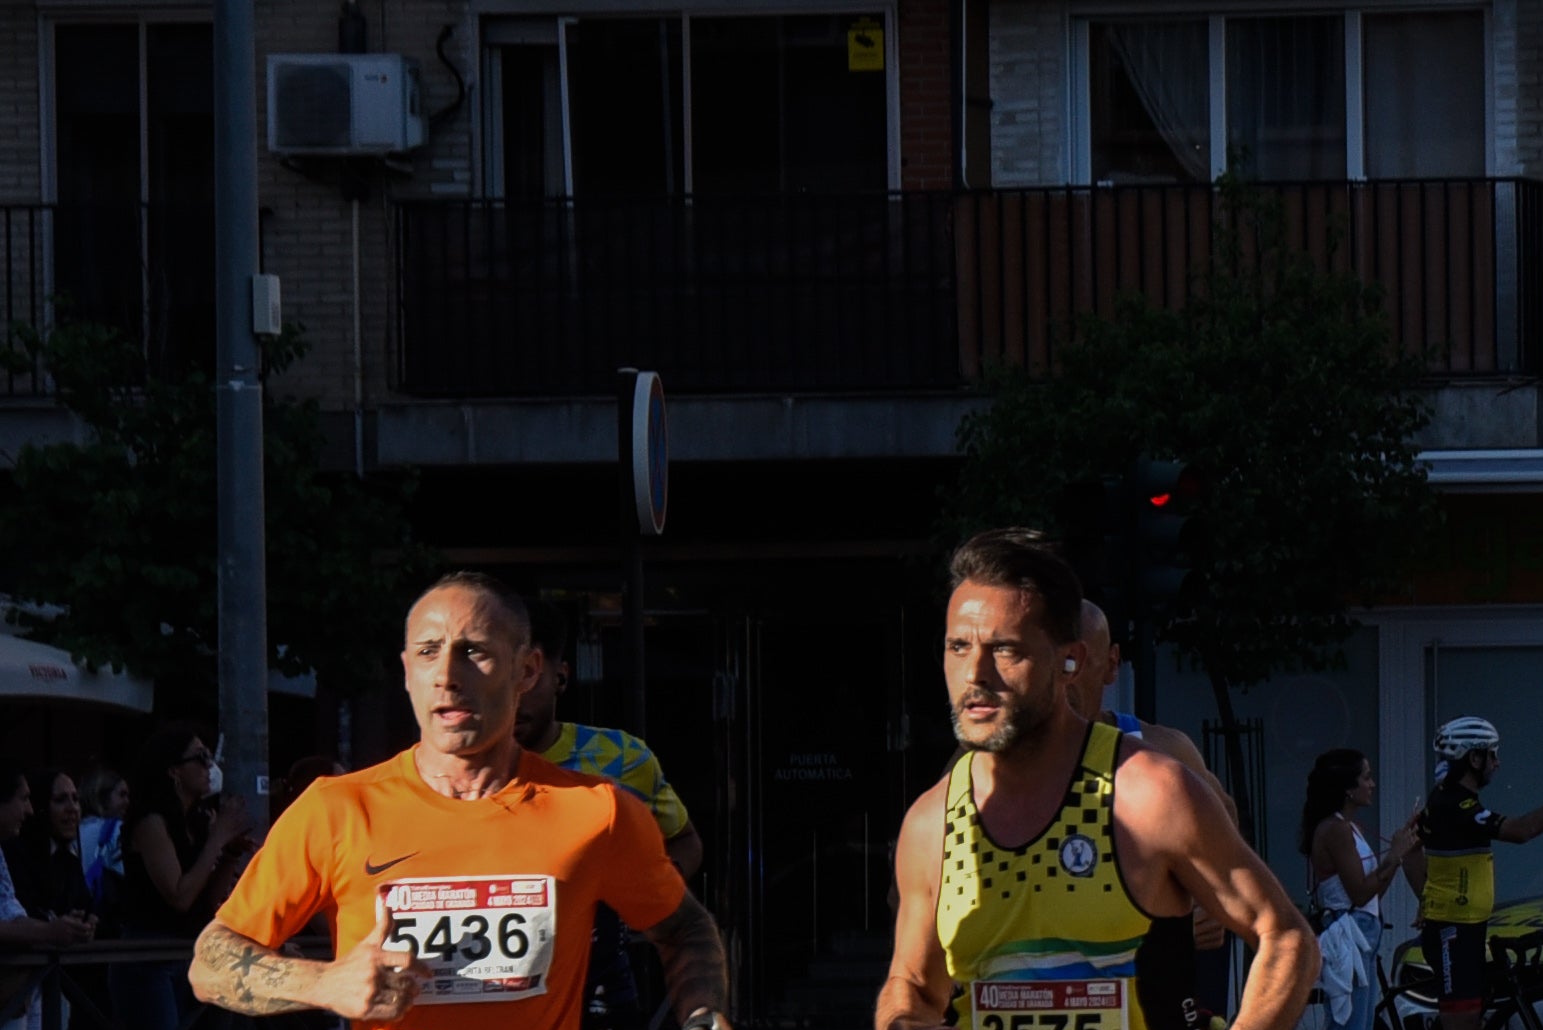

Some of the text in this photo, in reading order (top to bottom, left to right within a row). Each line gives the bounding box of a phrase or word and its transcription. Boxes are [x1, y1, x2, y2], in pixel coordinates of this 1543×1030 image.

[789, 752, 839, 767] PUERTA
[390, 913, 529, 961] 5436
[980, 985, 999, 1009] 40
